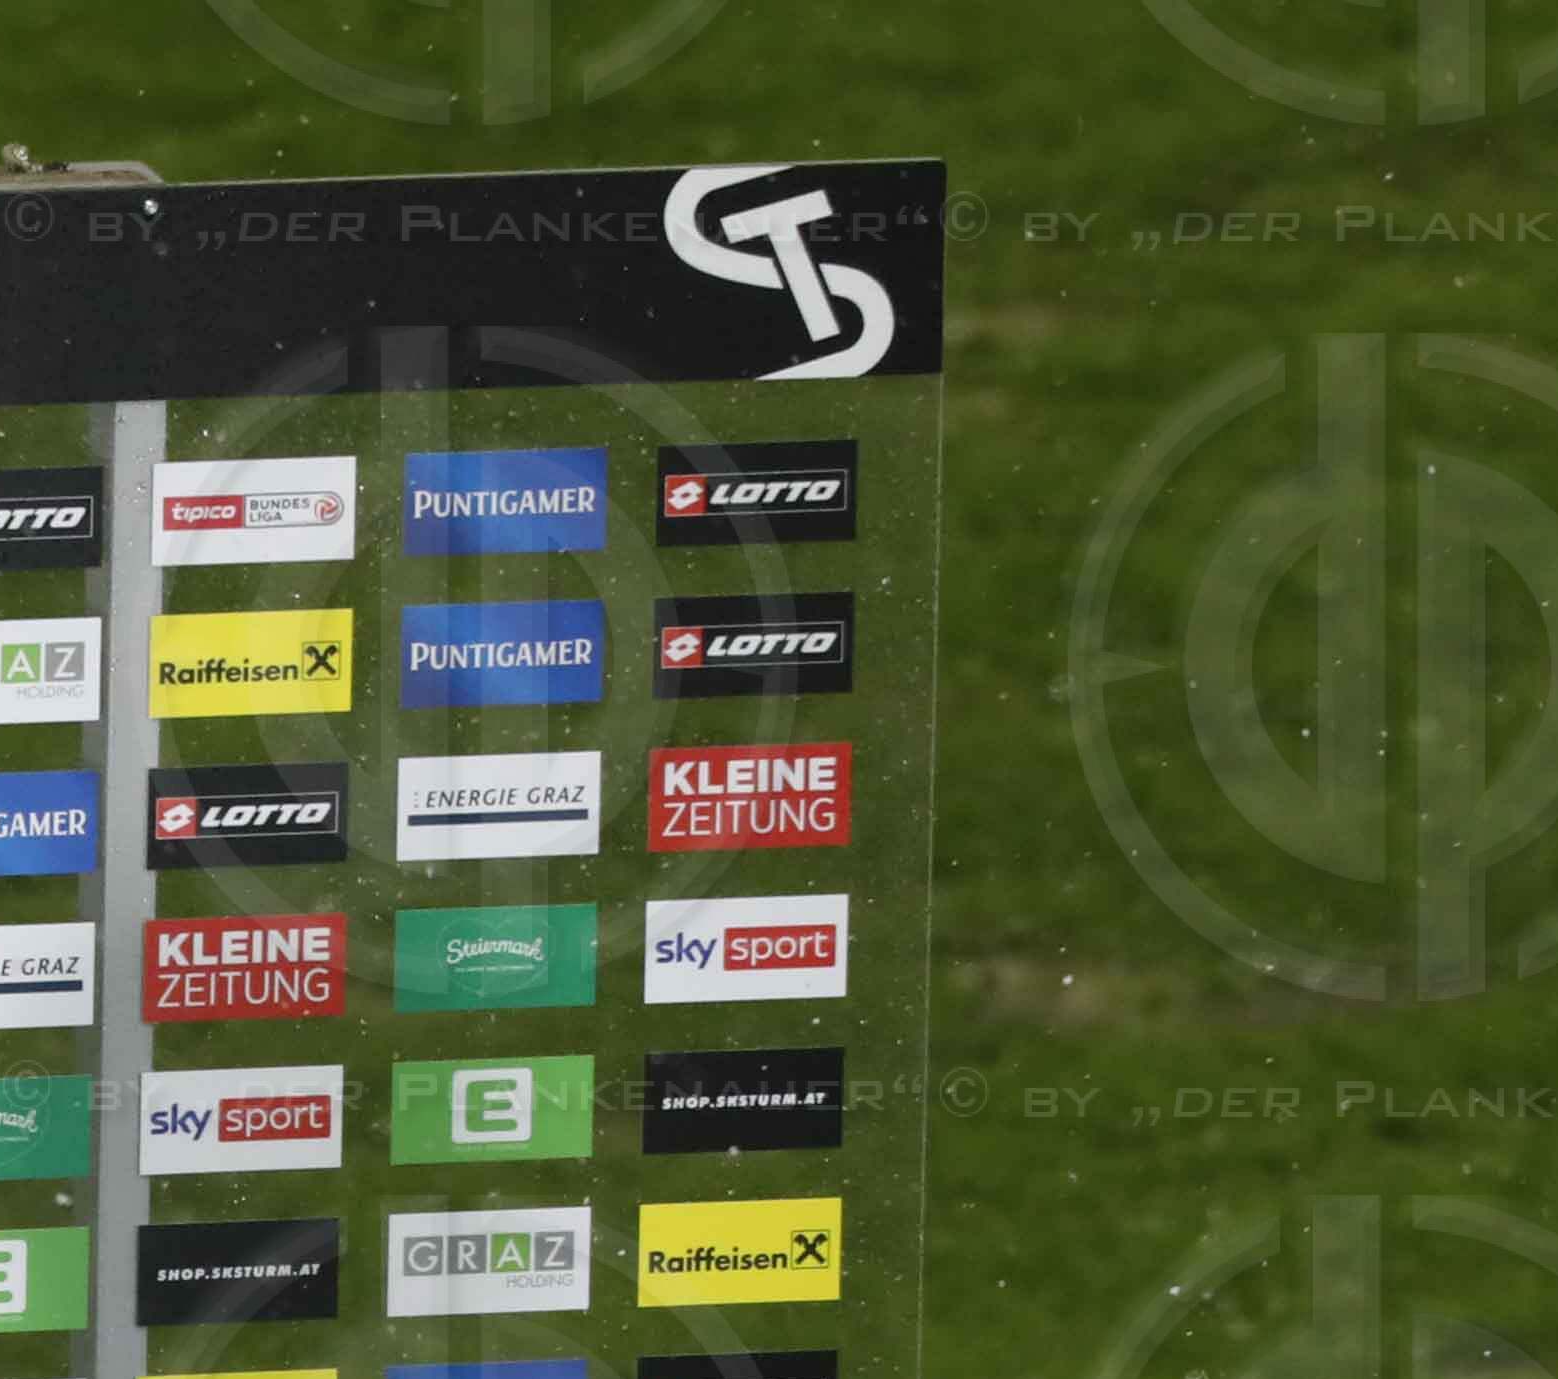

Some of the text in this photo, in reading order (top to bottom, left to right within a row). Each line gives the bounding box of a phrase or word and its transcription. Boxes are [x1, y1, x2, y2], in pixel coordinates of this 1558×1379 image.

[249, 497, 311, 511] BUNDES
[413, 486, 596, 519] PUNTIGAMER
[709, 478, 842, 505] LOTTO
[170, 502, 237, 524] tipico
[249, 511, 284, 523] LIGA
[409, 638, 592, 671] PUNTIGAMER
[706, 630, 839, 657] LOTTO
[159, 657, 299, 685] Raiffeisen
[662, 755, 838, 796] KLEINE
[200, 801, 333, 828] LOTTO
[661, 796, 837, 837] ZEITUNG
[156, 926, 332, 967] KLEINE
[445, 937, 545, 965] Steiermark
[654, 930, 830, 970] sky sport
[21, 956, 81, 977] GRAZ
[155, 967, 331, 1008] ZEITUNG
[660, 1091, 826, 1110] SHOP.SKSTURM.AT
[149, 1102, 325, 1142] sky sport
[408, 1236, 568, 1272] GRAZ
[648, 1246, 788, 1274] Raiffeisen
[156, 1262, 322, 1281] SHOP.SKSTURM.AT
